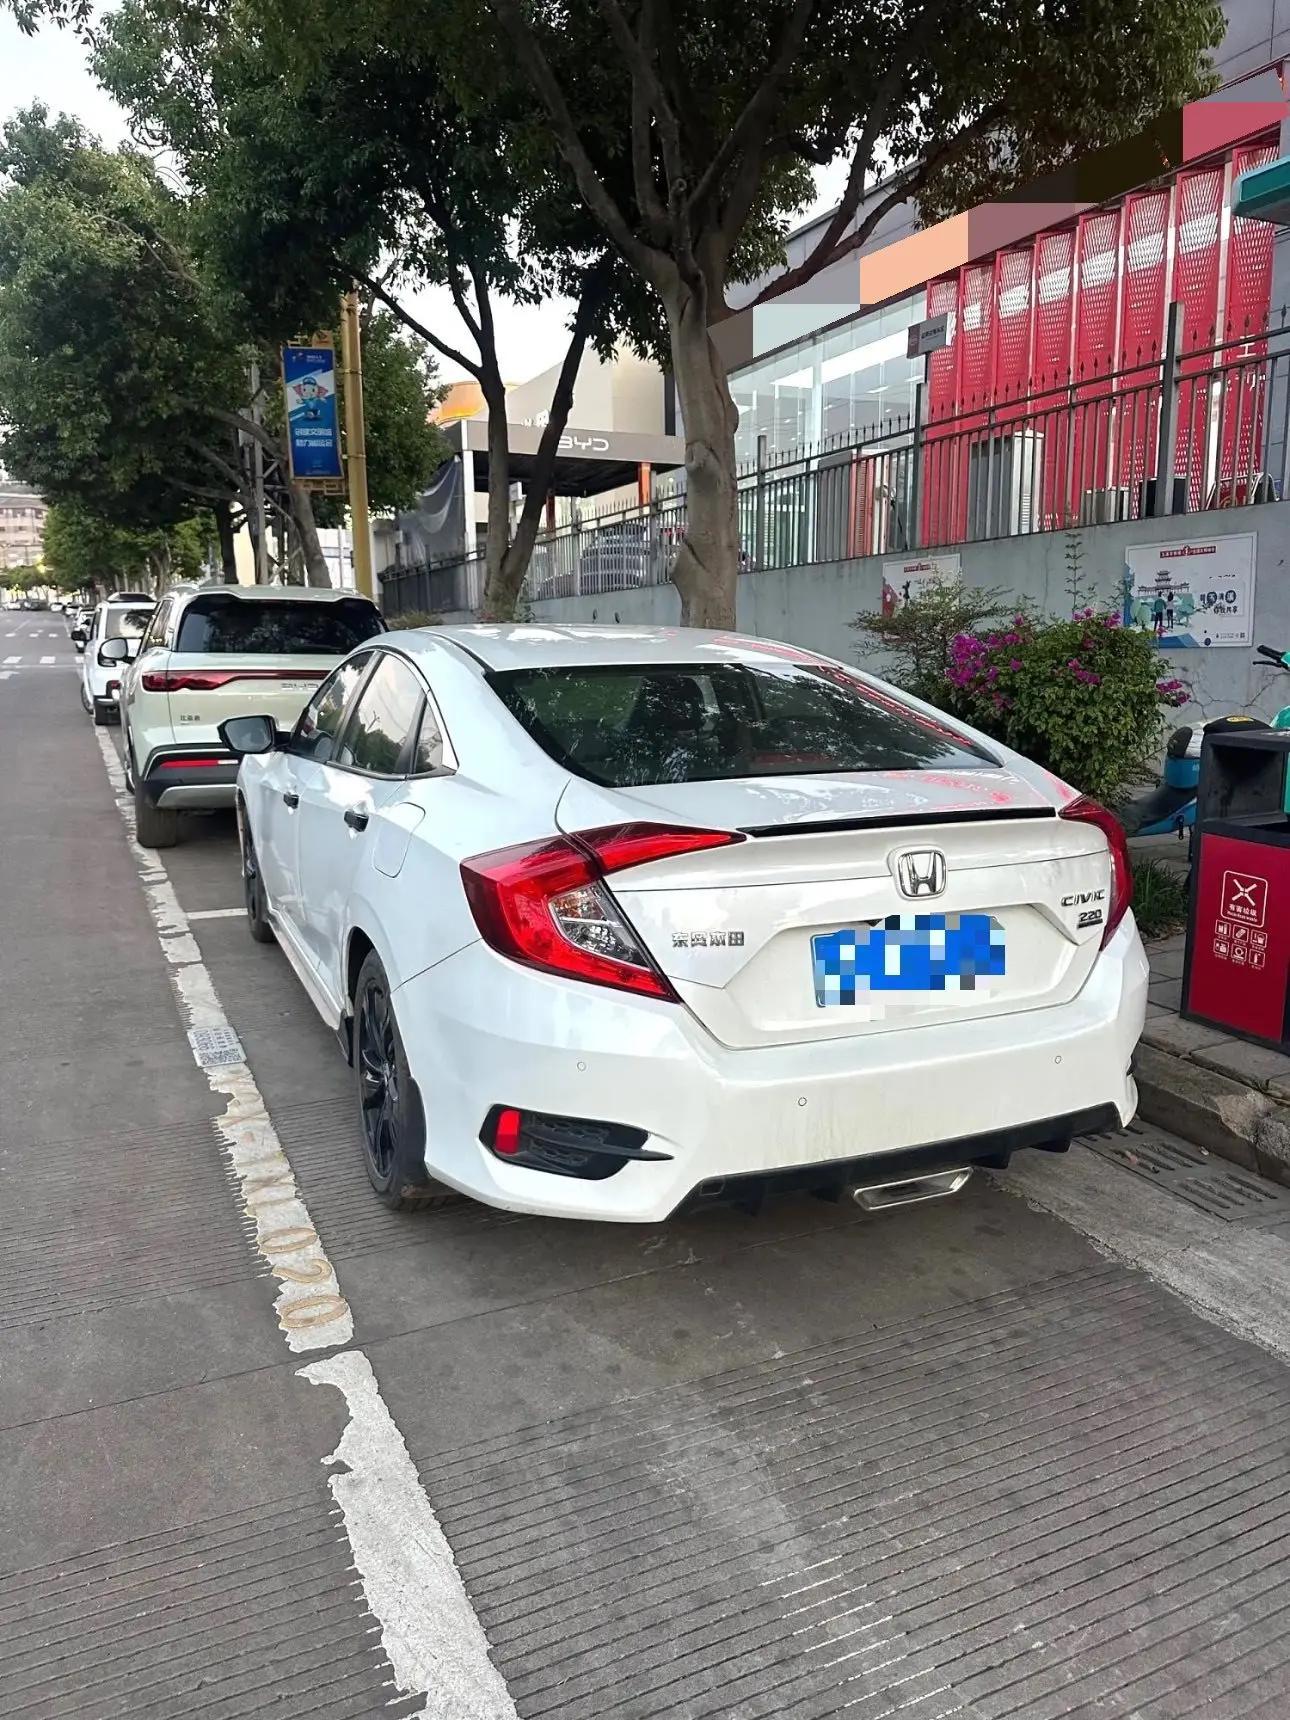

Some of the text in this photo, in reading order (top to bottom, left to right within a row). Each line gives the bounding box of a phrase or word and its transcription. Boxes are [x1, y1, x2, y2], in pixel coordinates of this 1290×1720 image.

[1061, 888, 1106, 907] CIVIC
[1078, 909, 1103, 922] 220
[671, 930, 745, 948] 东风本田
